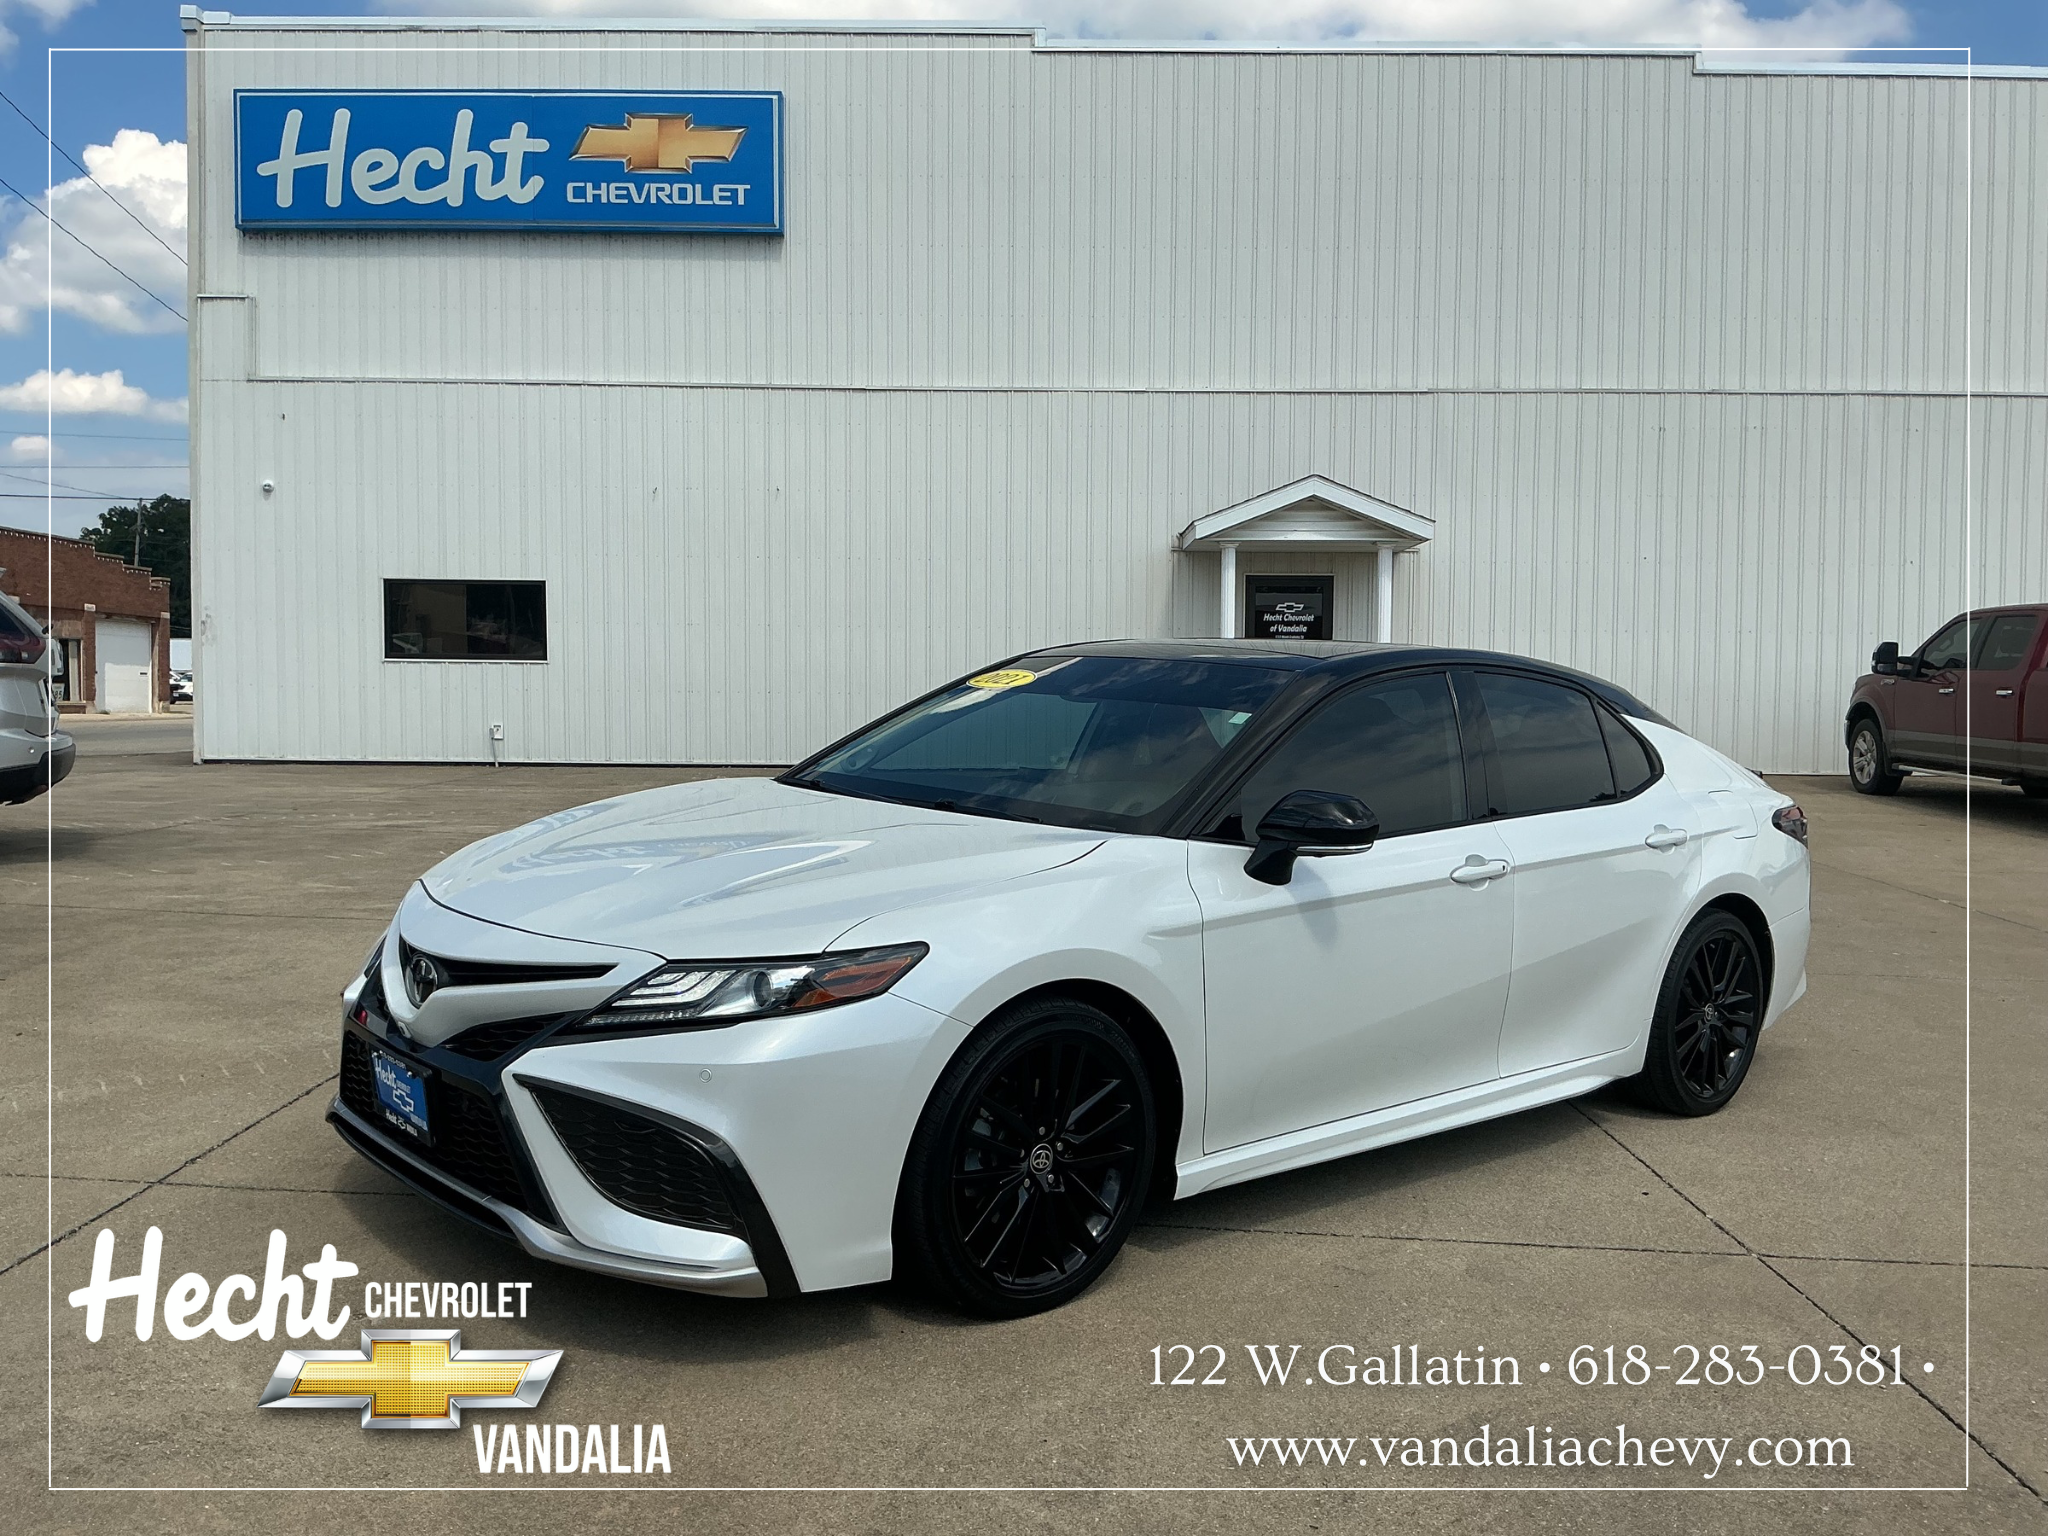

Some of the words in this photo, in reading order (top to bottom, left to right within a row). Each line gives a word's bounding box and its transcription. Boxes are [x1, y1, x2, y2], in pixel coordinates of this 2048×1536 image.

[256, 108, 550, 208] Hecht
[566, 182, 750, 206] CHEVROLET
[1263, 613, 1283, 622] Hecht
[1283, 613, 1315, 622] Chevrolet
[1269, 623, 1278, 633] of
[1278, 623, 1308, 633] Vandalia
